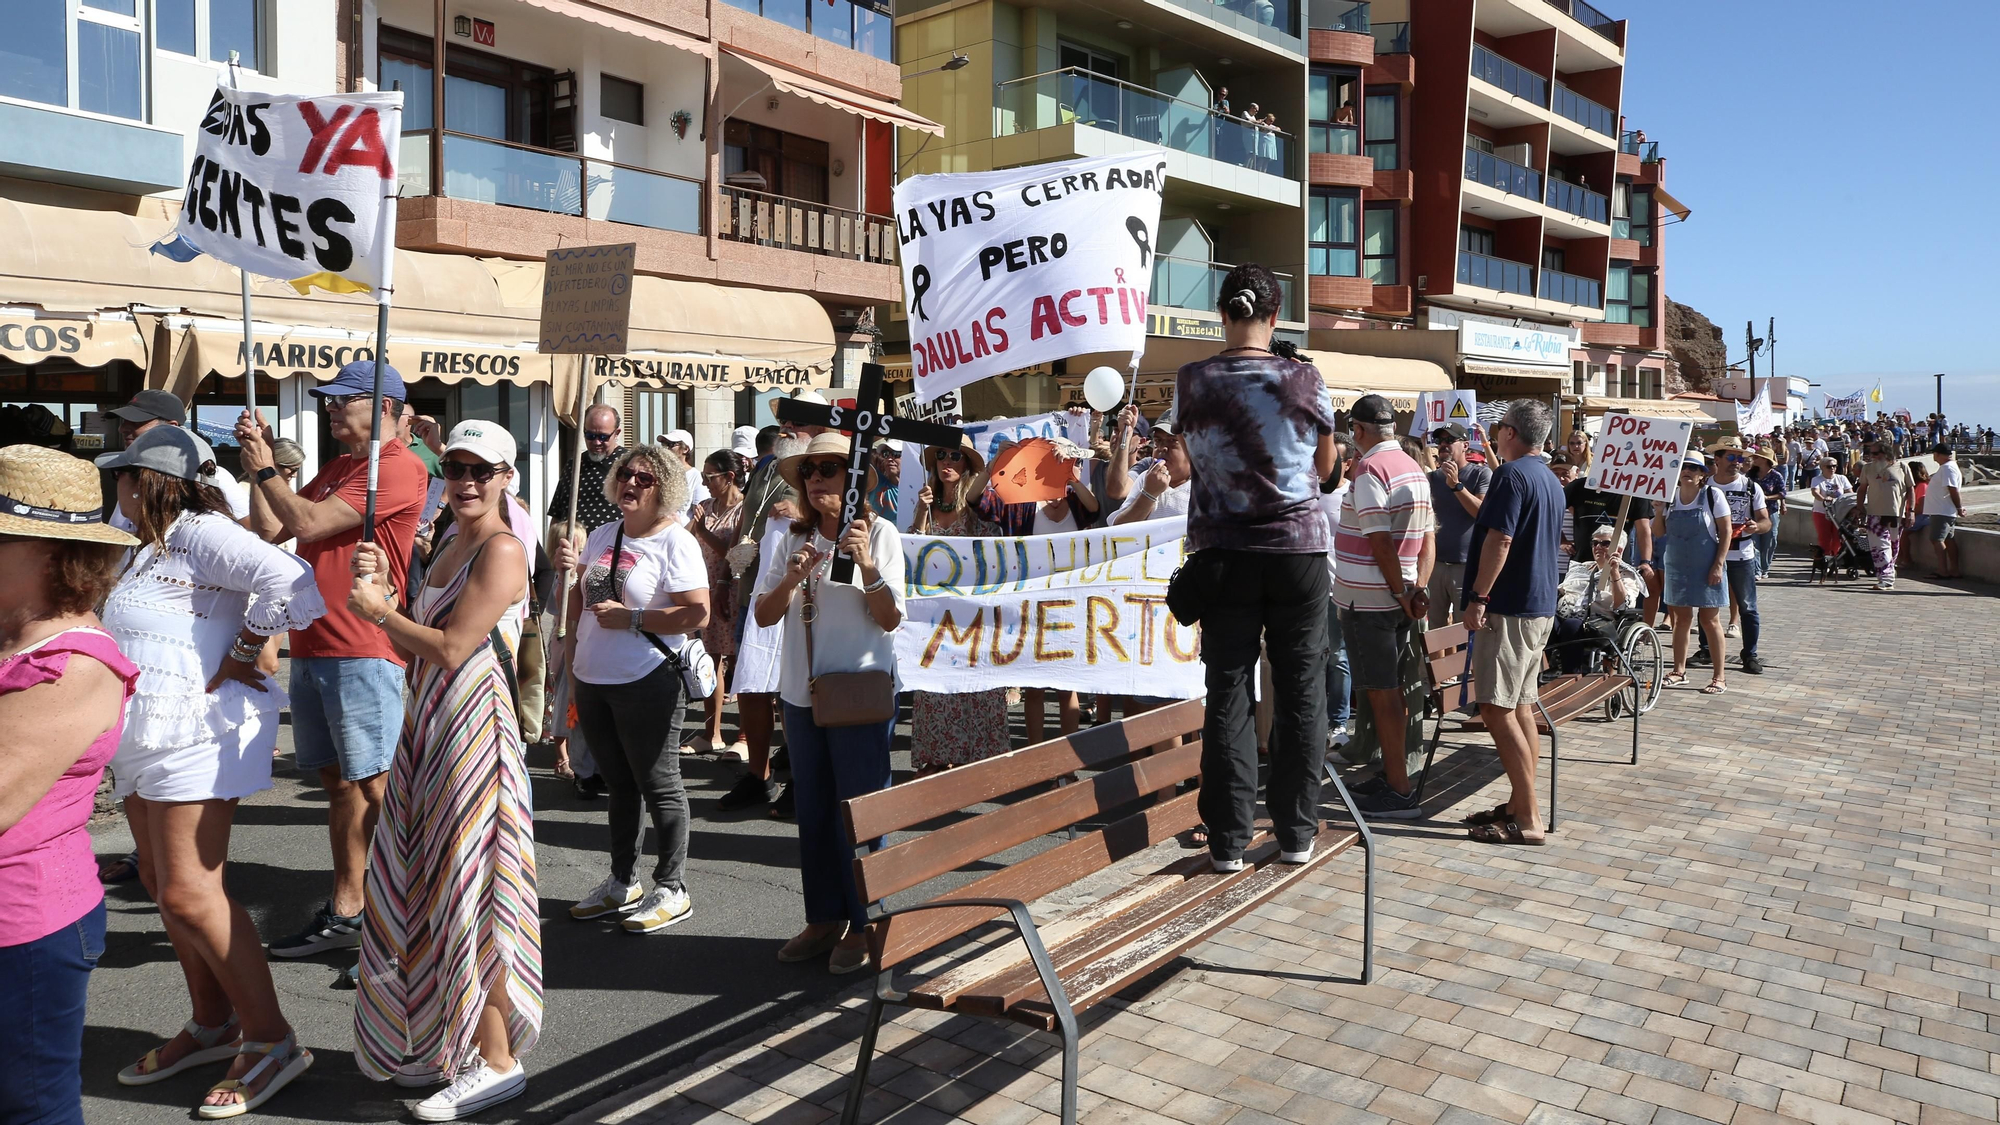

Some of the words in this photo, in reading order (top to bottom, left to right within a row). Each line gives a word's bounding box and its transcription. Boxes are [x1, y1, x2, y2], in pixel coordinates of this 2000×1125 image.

[297, 101, 395, 180] YA
[551, 266, 560, 277] EL
[565, 263, 583, 276] MAR
[586, 262, 598, 274] NO
[602, 261, 612, 272] ES
[615, 259, 627, 271] UN
[979, 232, 1068, 281] PERO
[554, 277, 607, 292] VERTEDERO
[545, 299, 580, 313] PLAYAS
[584, 299, 621, 314] LIMPIAS
[546, 321, 561, 333] SIN
[913, 307, 1009, 377] JAULAS
[1474, 332, 1512, 350] RESTAURANTE
[1531, 332, 1563, 361] Rubia
[420, 351, 520, 376] FRESCOS
[594, 356, 730, 383] RESTAURANTE
[743, 365, 812, 386] VENECIA
[829, 406, 894, 435] SOS
[1427, 400, 1445, 422] NO
[1607, 416, 1651, 436] POR
[1601, 444, 1664, 470] PLAYA
[1642, 437, 1678, 454] UNA
[1599, 468, 1667, 499] LIMPIA
[919, 593, 1202, 668] MUERTO
